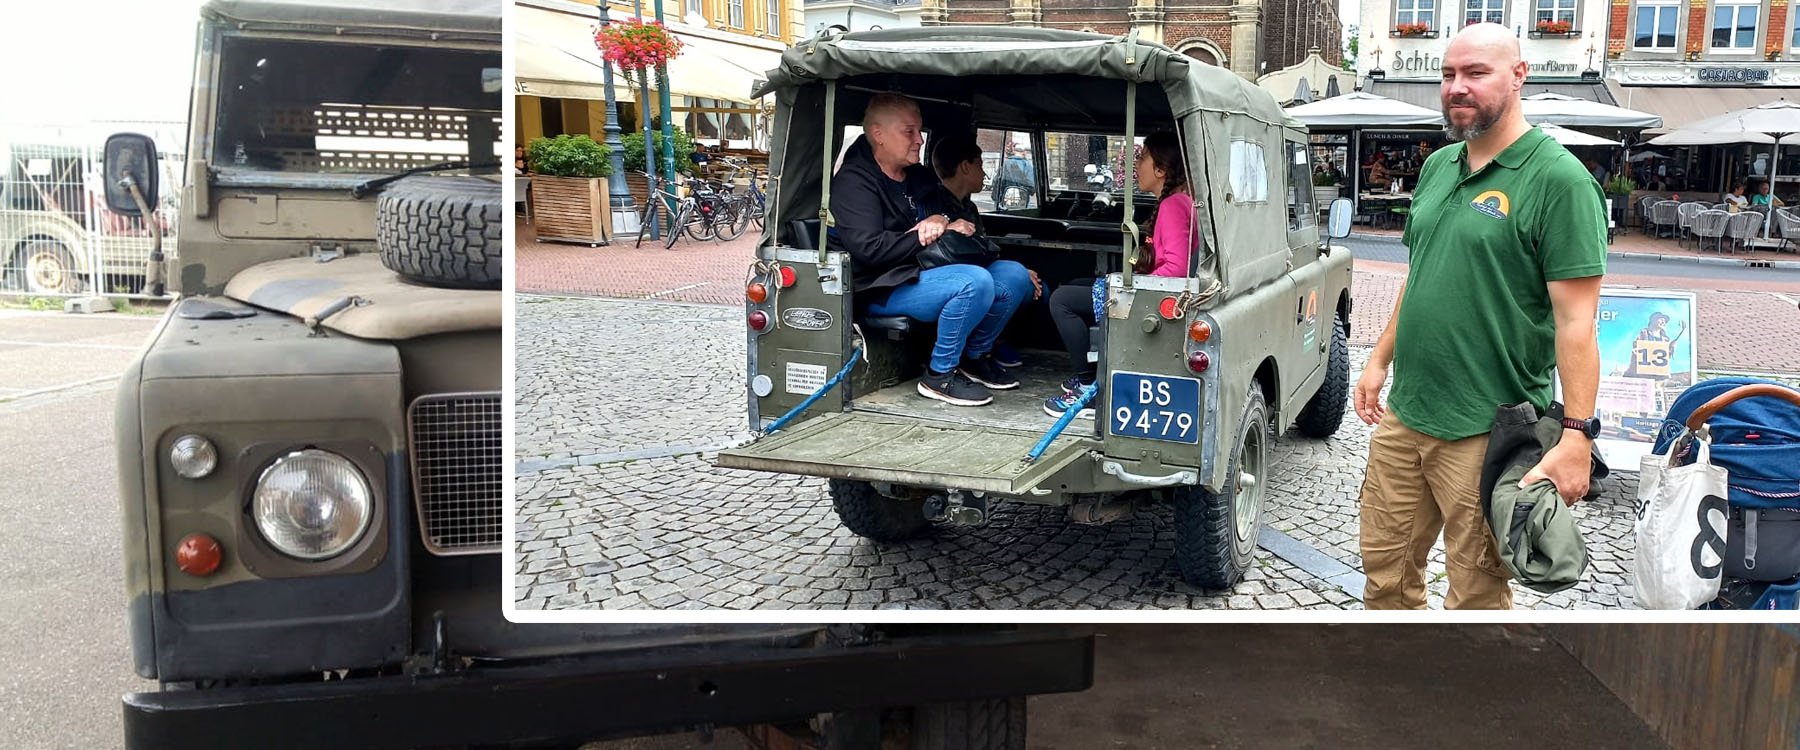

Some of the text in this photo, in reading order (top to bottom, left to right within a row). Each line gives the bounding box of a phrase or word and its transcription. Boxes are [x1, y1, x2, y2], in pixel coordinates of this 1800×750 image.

[1638, 348, 1669, 367] 13
[1139, 379, 1171, 406] BS
[1116, 406, 1193, 438] 94-79
